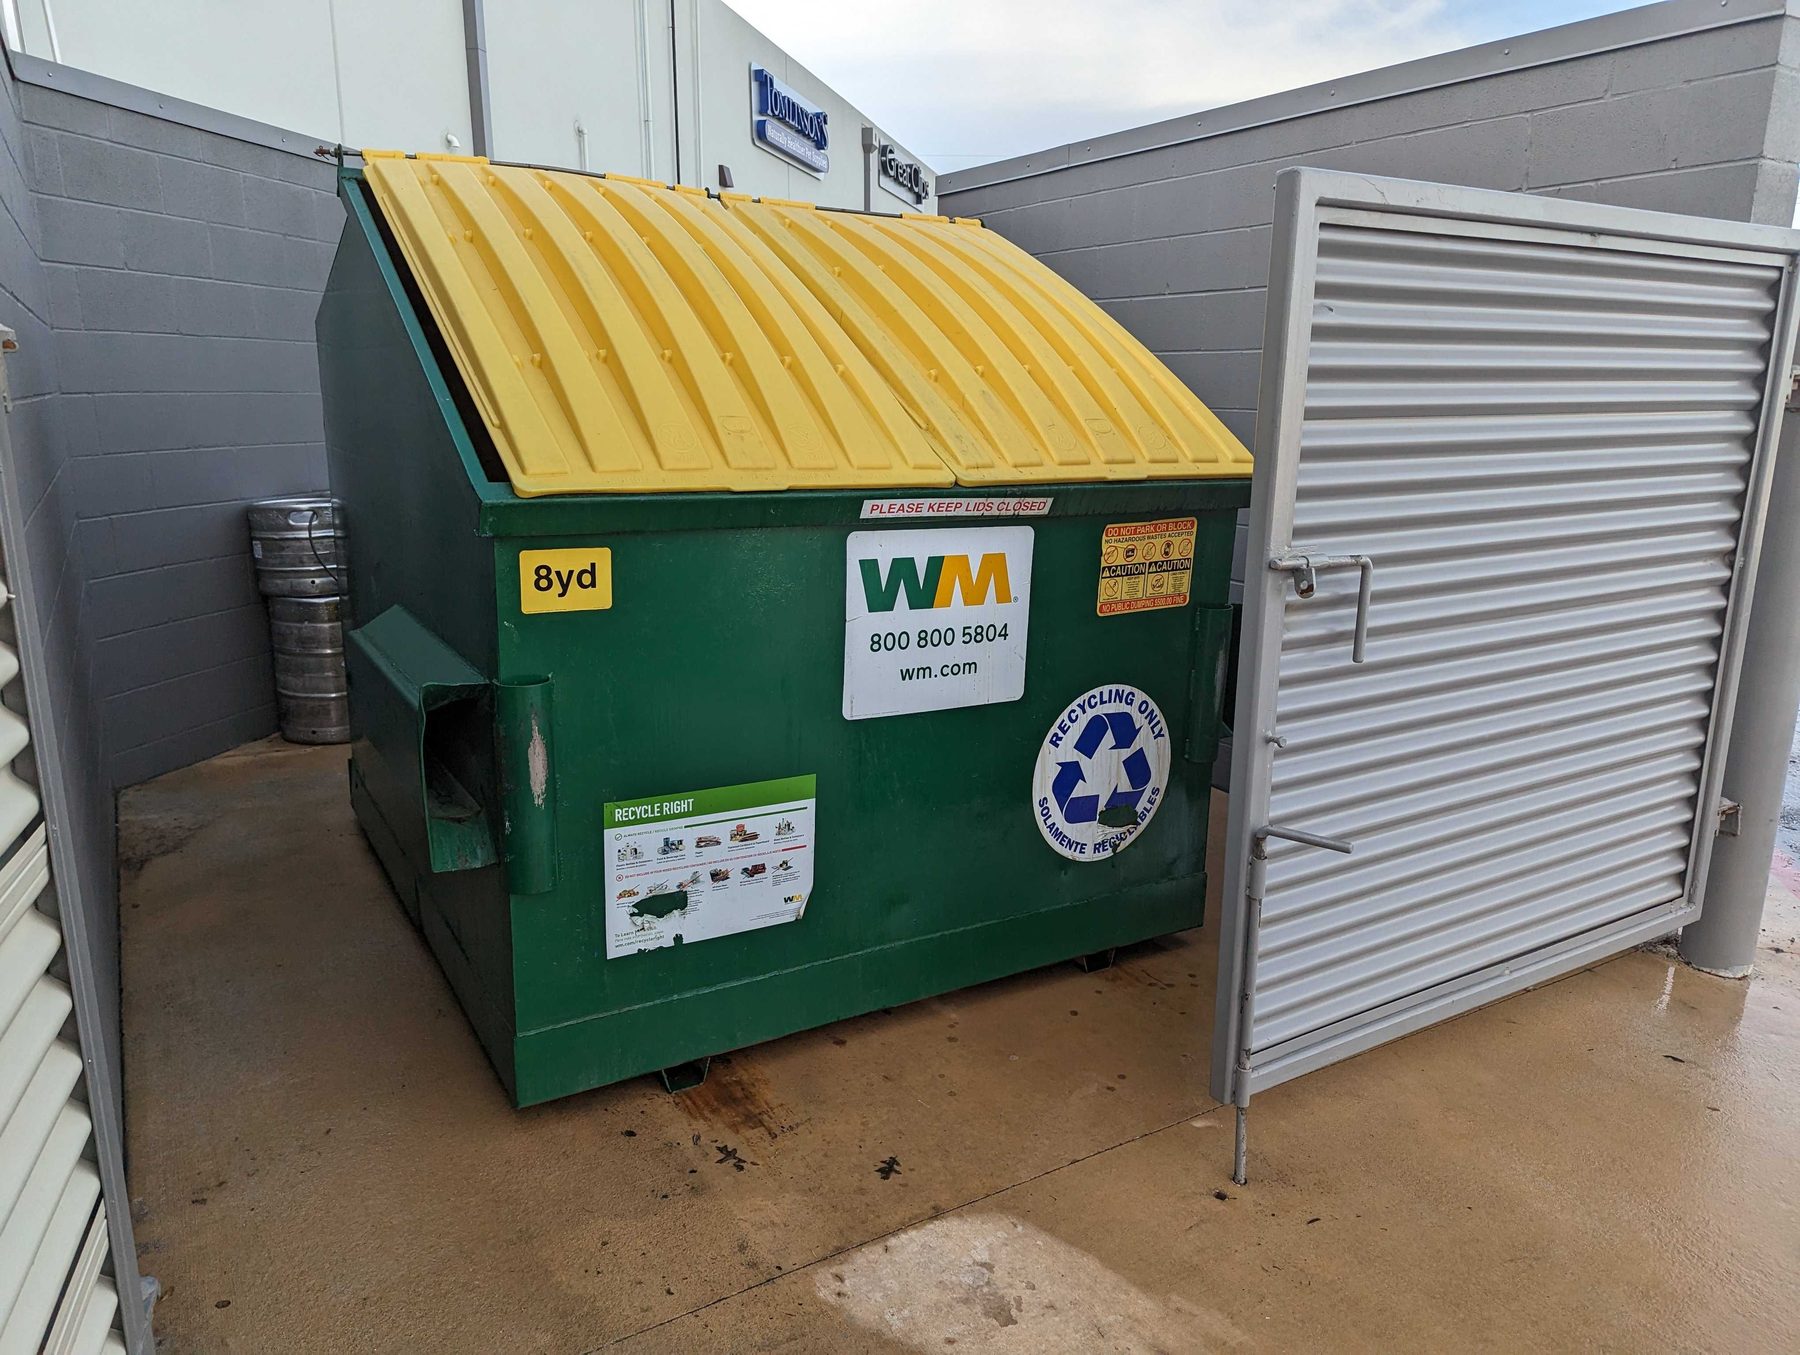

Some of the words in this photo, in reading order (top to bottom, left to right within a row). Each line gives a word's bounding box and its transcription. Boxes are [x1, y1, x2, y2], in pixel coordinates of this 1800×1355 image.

[881, 145, 912, 189] Great
[870, 503, 925, 515] PLEASE
[927, 501, 963, 513] KEEP
[965, 500, 994, 511] LIDS
[996, 499, 1047, 512] CLOSED
[1108, 528, 1119, 537] DO
[1120, 526, 1135, 536] NOT
[1137, 524, 1155, 534] PARK
[1156, 523, 1167, 532] OR
[1167, 520, 1193, 531] BLOCK
[1113, 535, 1146, 544] HAZARDOUS
[1146, 533, 1167, 541] WASTES
[1167, 531, 1194, 539] ACCEPTED
[1110, 563, 1146, 576] CAUTION
[1156, 558, 1191, 571] CAUTION
[533, 562, 597, 598] 8yd
[859, 552, 1012, 613] WM
[1101, 603, 1111, 613] NO
[1111, 602, 1130, 612] PUBLIC
[1173, 595, 1185, 605] FINE
[870, 631, 910, 652] 800
[917, 627, 955, 649] 800
[961, 622, 1009, 645] 5804
[900, 660, 978, 682] wm.com
[1048, 688, 1136, 748] RECYCLING
[1137, 699, 1165, 741] ONLY
[615, 803, 661, 822] RECYCLE
[663, 798, 695, 816] RIGHT
[1039, 796, 1088, 855] SOLAMENTE
